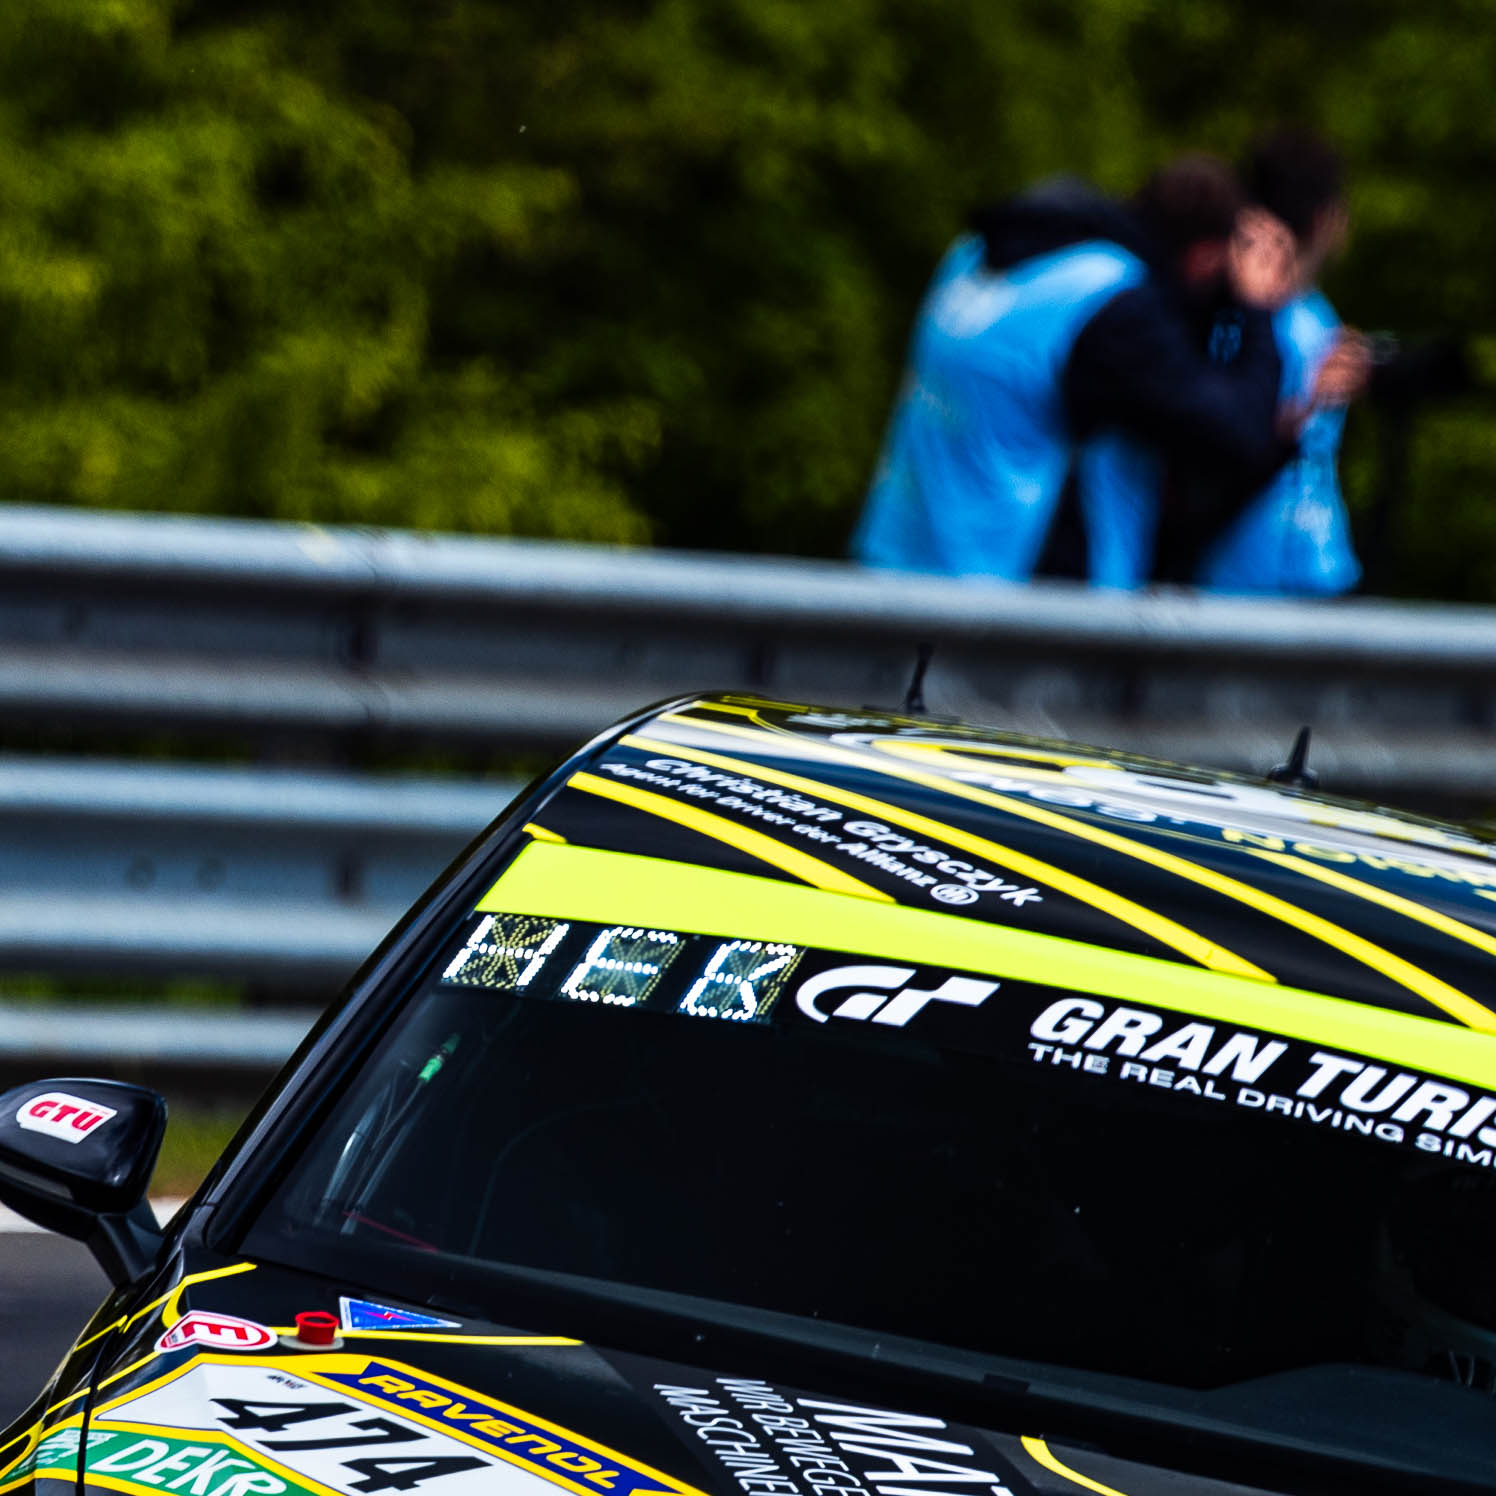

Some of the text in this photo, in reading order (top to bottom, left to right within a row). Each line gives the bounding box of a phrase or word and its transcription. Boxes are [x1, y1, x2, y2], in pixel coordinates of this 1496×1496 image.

[645, 758, 843, 822] Christian
[836, 841, 939, 888] Allianz
[1029, 997, 1289, 1085] GRAN
[1027, 1042, 1111, 1075] THE
[1119, 1060, 1227, 1101] REAL
[1236, 1087, 1405, 1144] DRIVING
[358, 1372, 627, 1491] RAVENOL
[715, 1377, 795, 1413] WIR
[208, 1397, 495, 1495] 474
